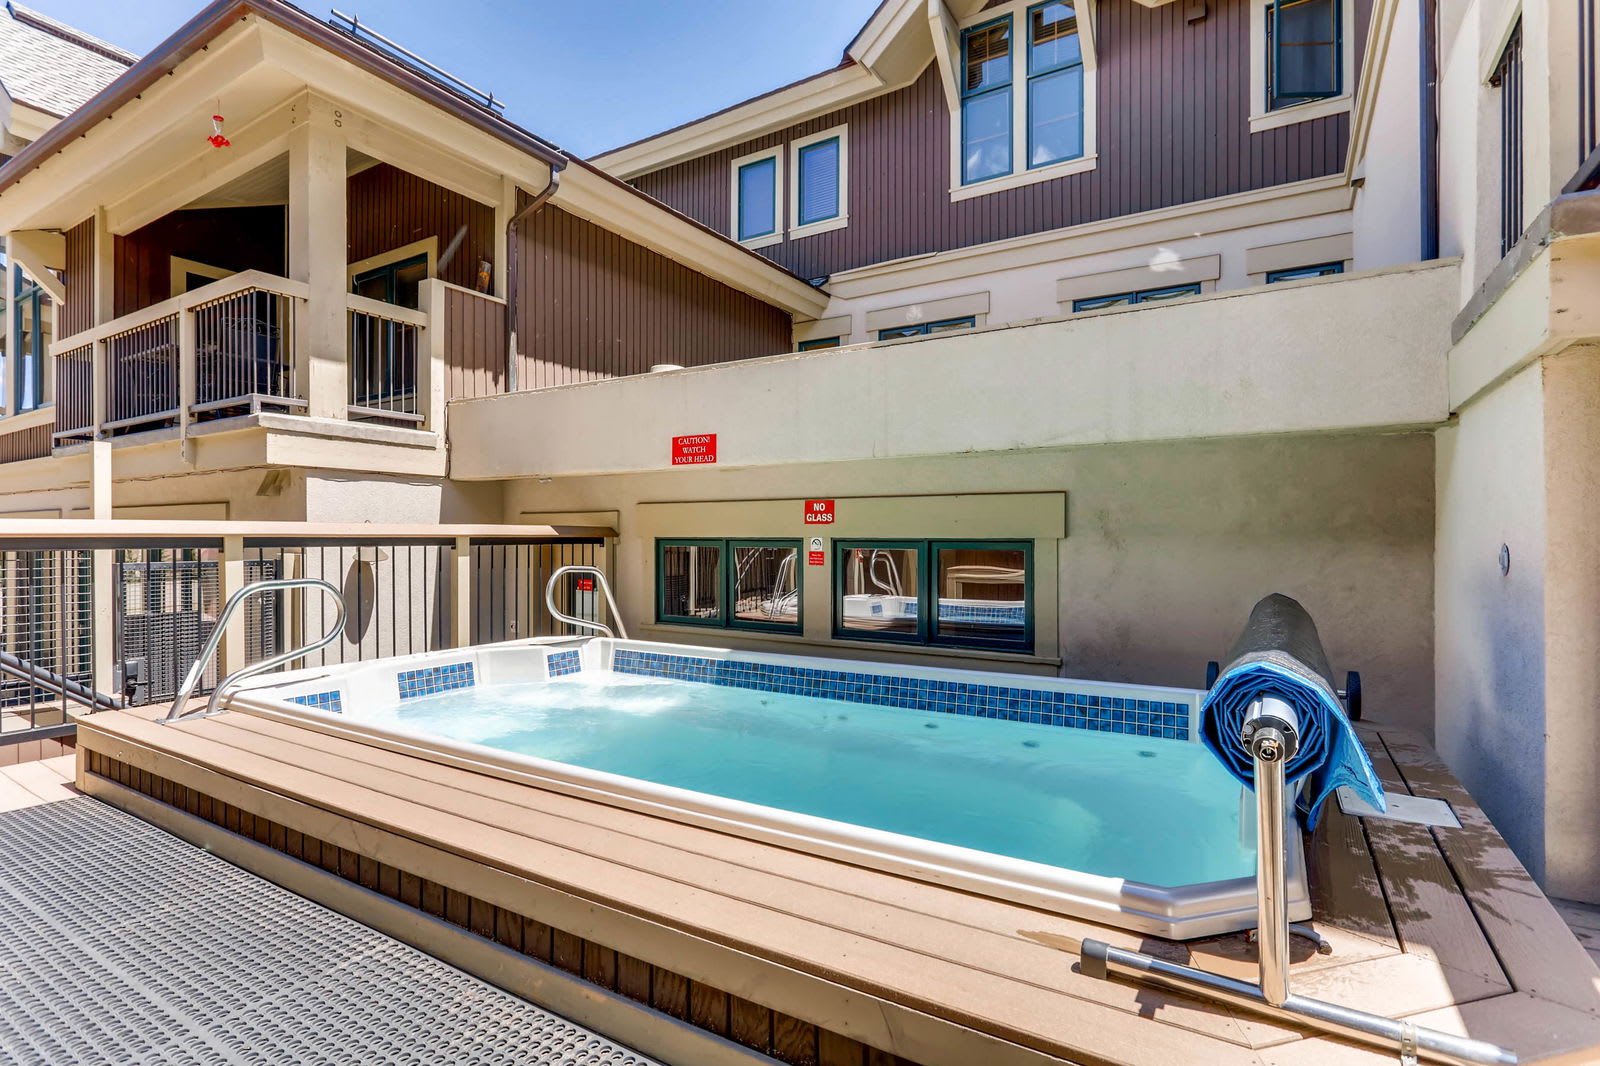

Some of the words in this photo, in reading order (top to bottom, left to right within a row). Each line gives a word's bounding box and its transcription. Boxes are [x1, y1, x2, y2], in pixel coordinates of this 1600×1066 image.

[682, 446, 706, 454] WATCH
[674, 456, 693, 464] YOUR
[694, 454, 714, 463] HEAD
[813, 503, 826, 511] NO
[806, 513, 833, 522] GLASS
